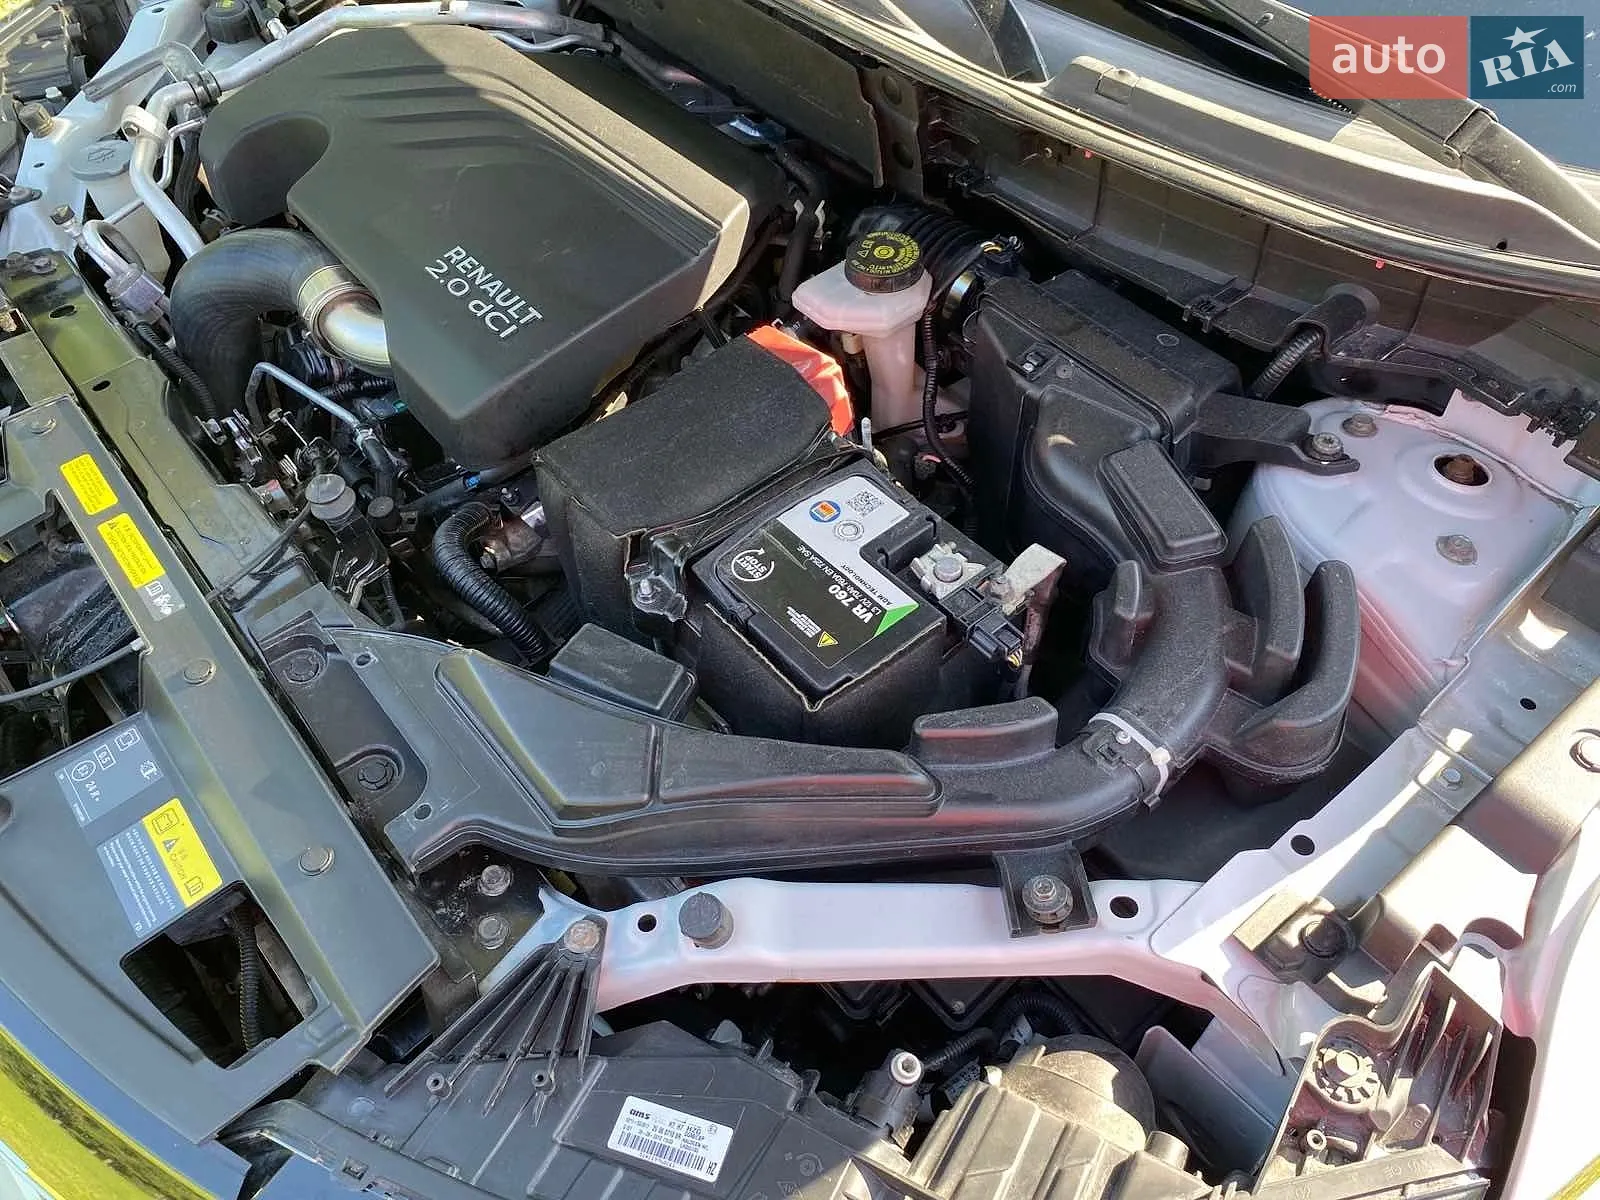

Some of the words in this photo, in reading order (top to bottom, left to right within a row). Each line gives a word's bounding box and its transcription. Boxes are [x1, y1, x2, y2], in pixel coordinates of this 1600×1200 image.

[424, 258, 470, 297] 2.0
[443, 245, 544, 325] RENAULT
[796, 544, 812, 558] SAE
[735, 557, 763, 579] START
[744, 555, 769, 573] STOP
[840, 563, 879, 596] TECHNOLOGY
[828, 584, 856, 607] 760
[845, 584, 862, 600] 70Ah
[859, 597, 873, 608] 12V
[851, 603, 874, 624] VR
